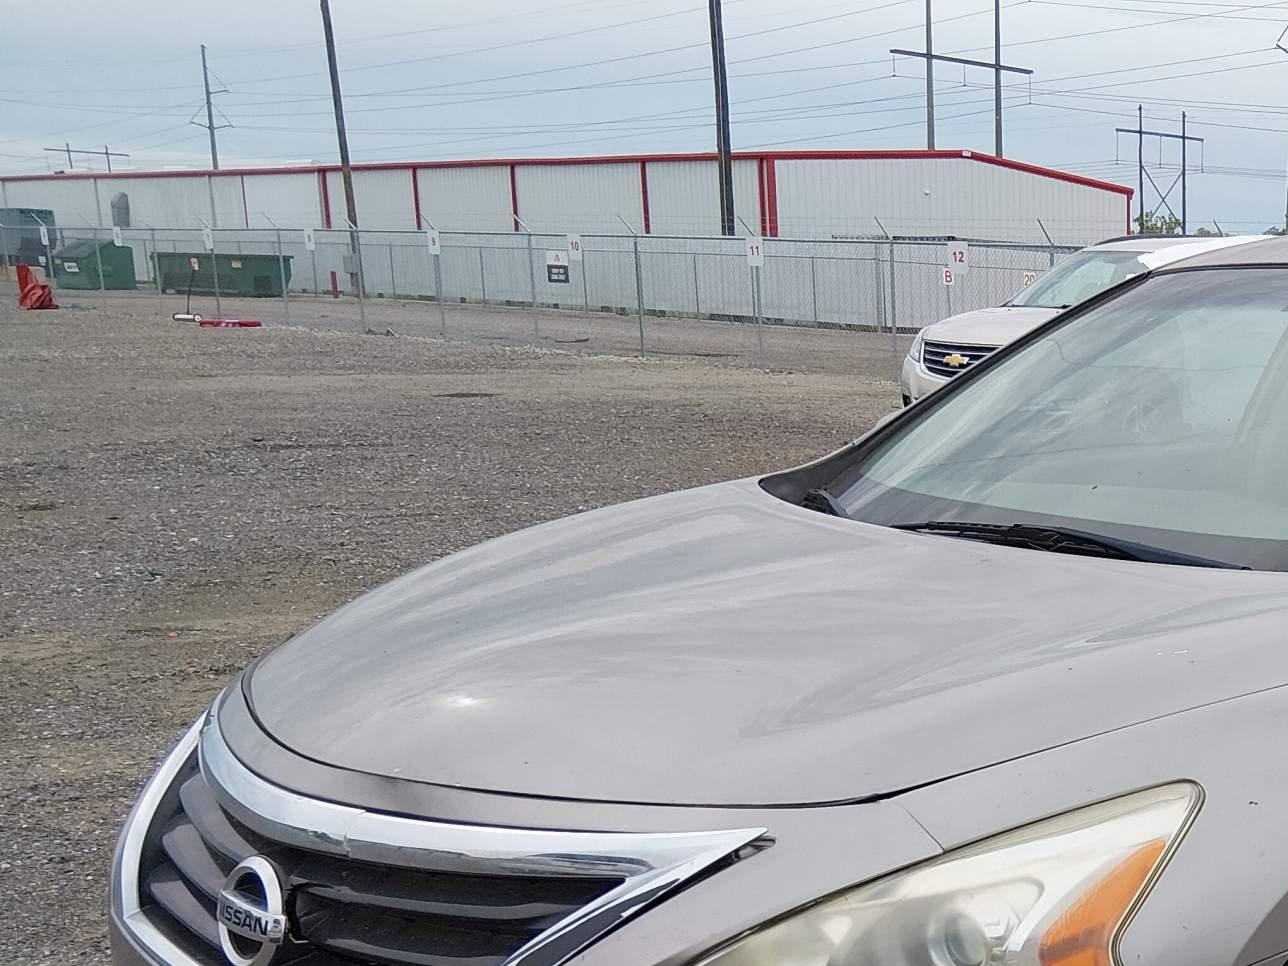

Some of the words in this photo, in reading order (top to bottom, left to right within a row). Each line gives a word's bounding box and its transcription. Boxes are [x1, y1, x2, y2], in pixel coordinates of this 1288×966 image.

[570, 240, 580, 251] 10
[750, 245, 760, 256] 11
[952, 251, 965, 263] 12
[944, 271, 953, 283] B
